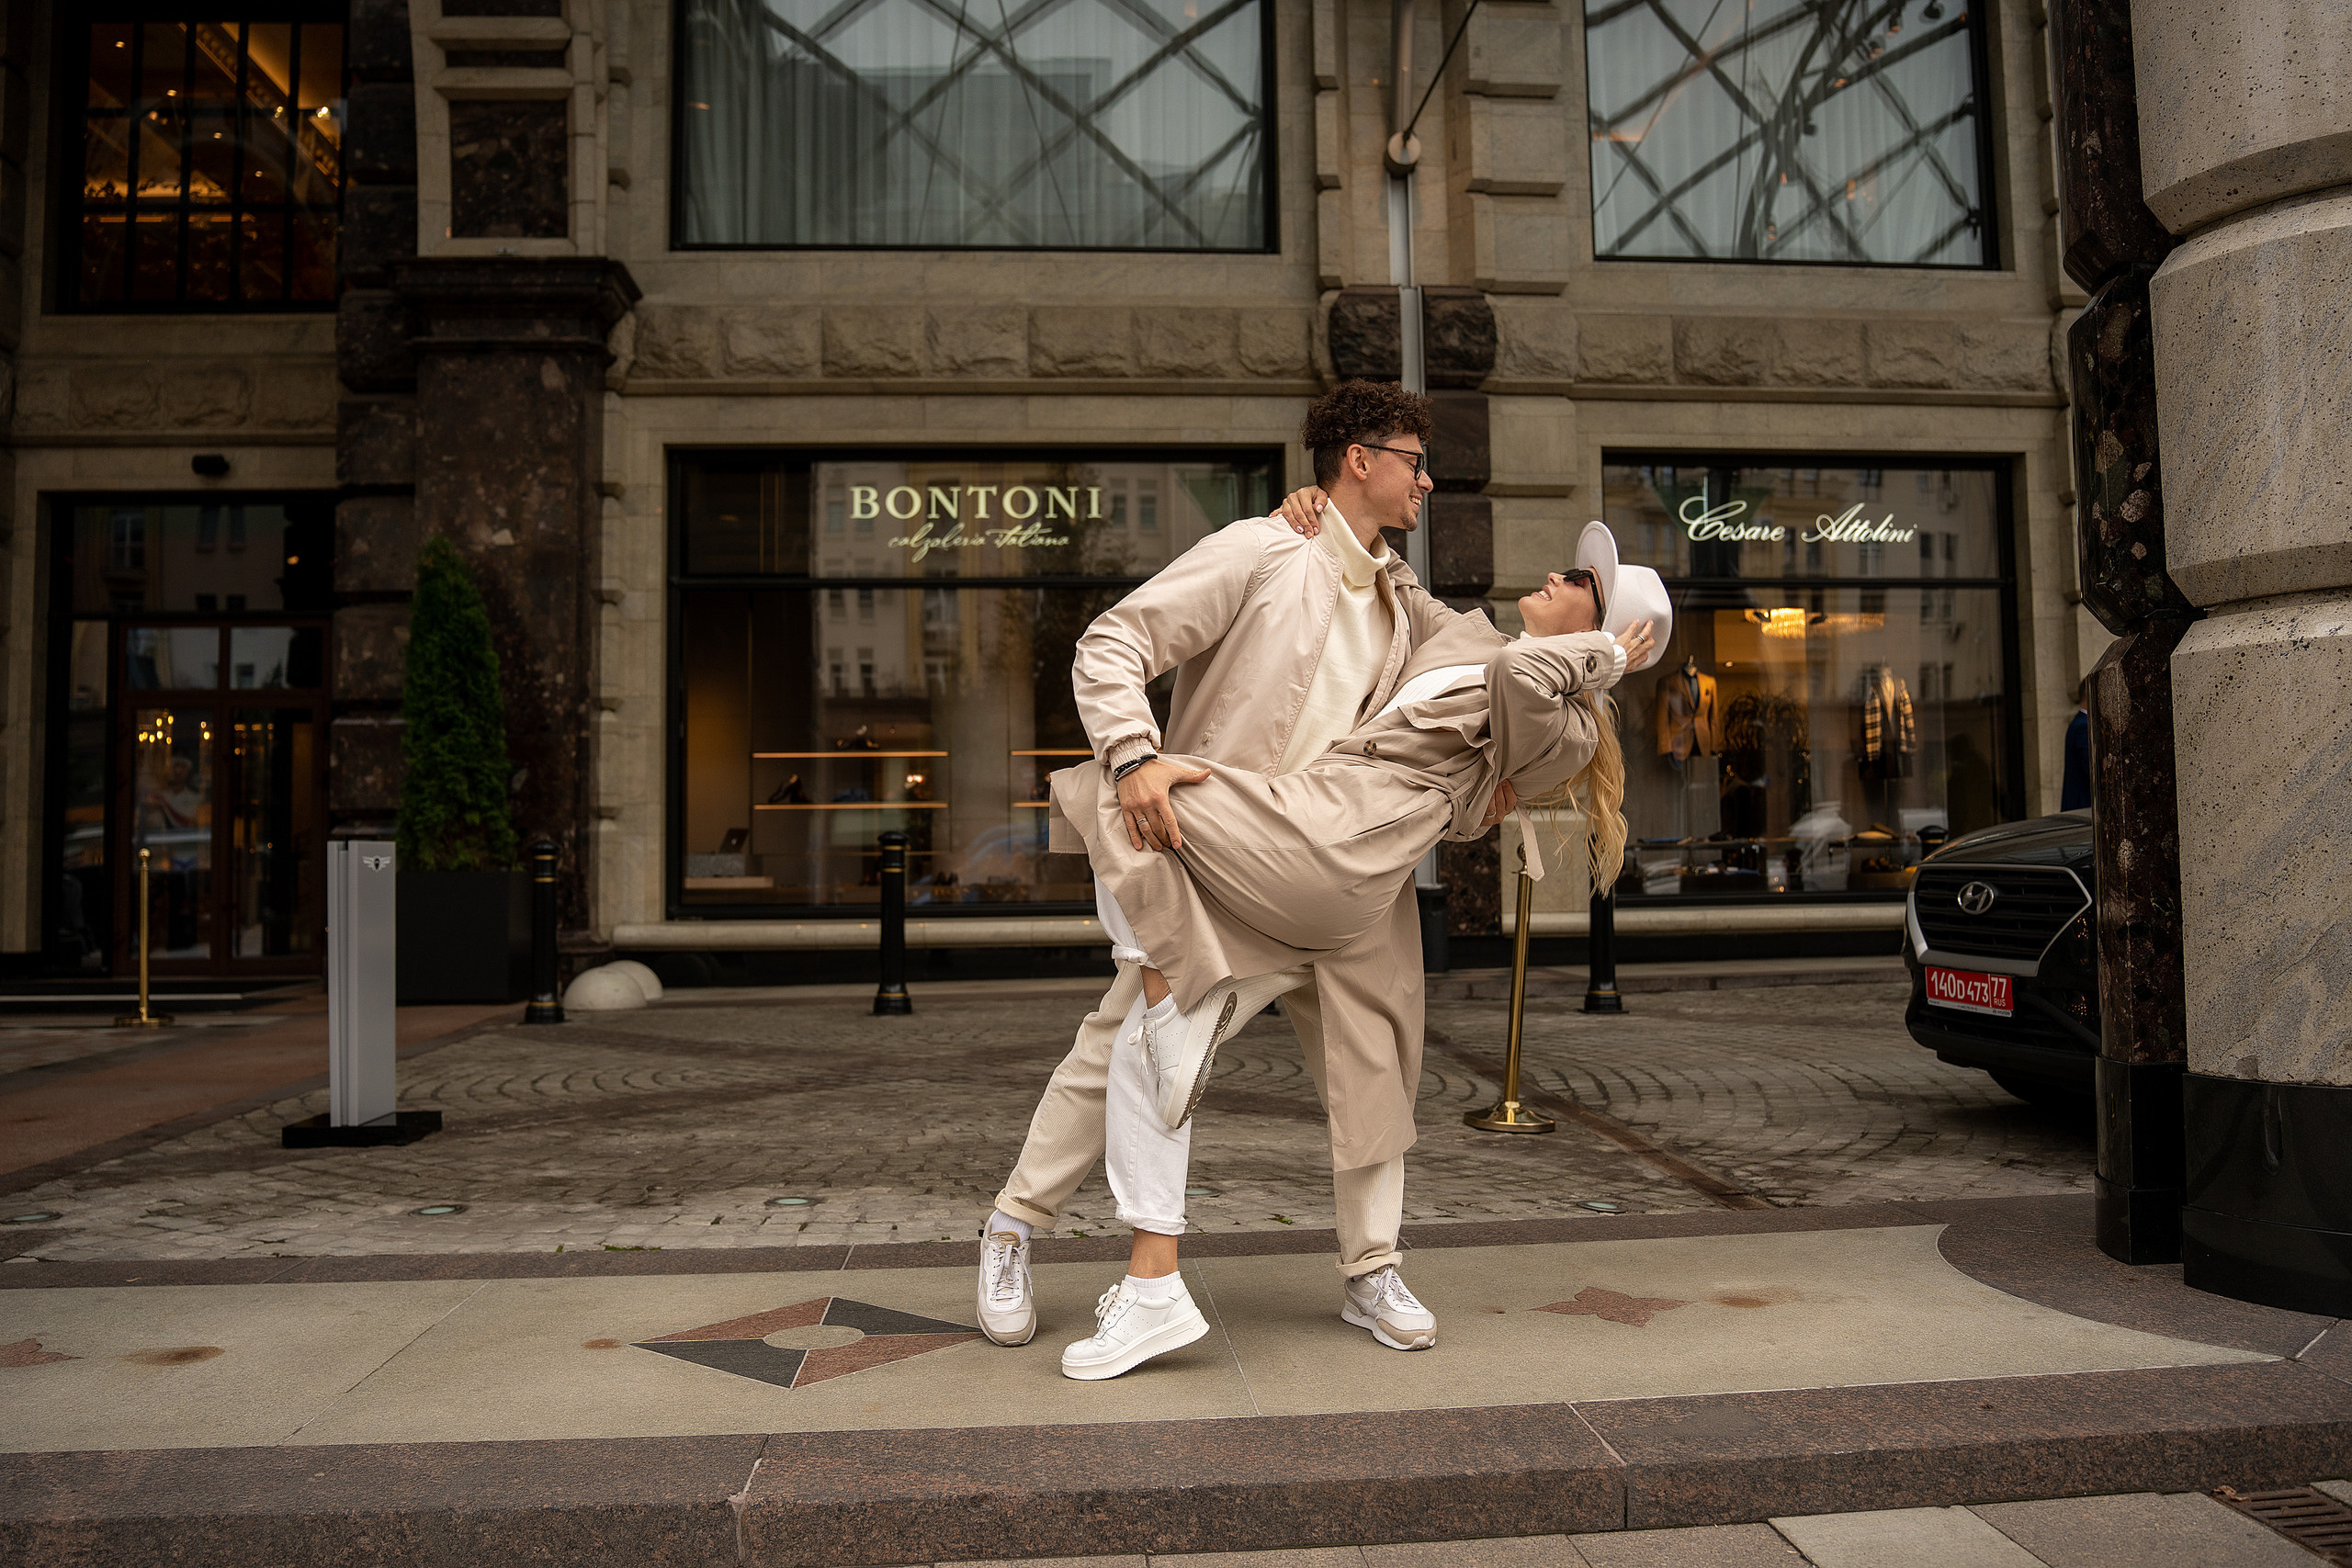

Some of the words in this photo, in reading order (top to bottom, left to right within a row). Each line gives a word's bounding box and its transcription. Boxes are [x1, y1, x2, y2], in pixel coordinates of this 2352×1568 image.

[849, 485, 1102, 519] BONTONI
[1679, 495, 1786, 542] Cesare
[1801, 502, 1918, 543] Attolini
[888, 521, 986, 563] calzoleria
[986, 521, 1069, 549] italiana
[1991, 976, 2007, 998] 77
[1994, 998, 2007, 1008] RUS
